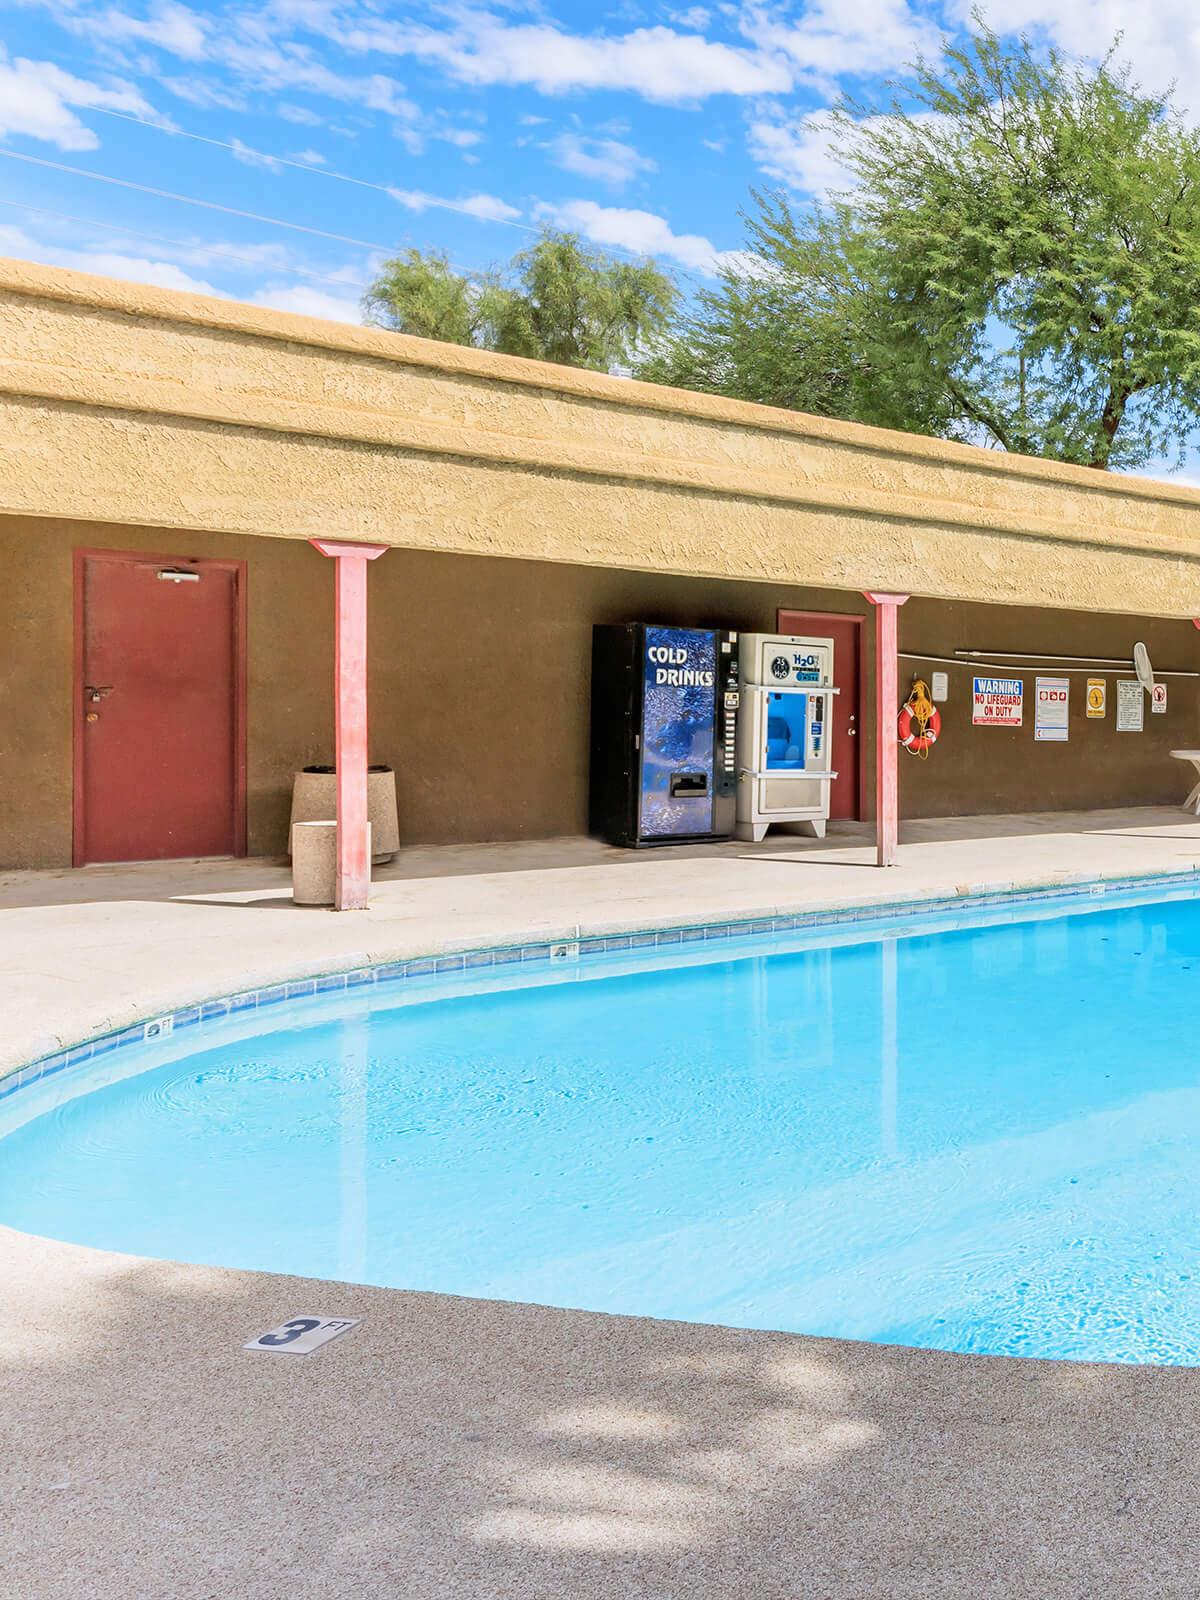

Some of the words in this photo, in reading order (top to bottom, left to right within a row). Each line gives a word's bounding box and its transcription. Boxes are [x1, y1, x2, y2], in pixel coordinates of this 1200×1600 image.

[648, 646, 688, 664] COLD
[656, 668, 713, 687] DRINKS
[977, 679, 1020, 695] WARNING
[975, 694, 984, 705] NO
[987, 694, 1021, 706] LIFEGUARD
[984, 706, 993, 716] ON
[995, 706, 1012, 717] DUTY
[258, 1319, 321, 1346] 3
[321, 1321, 352, 1331] FT
